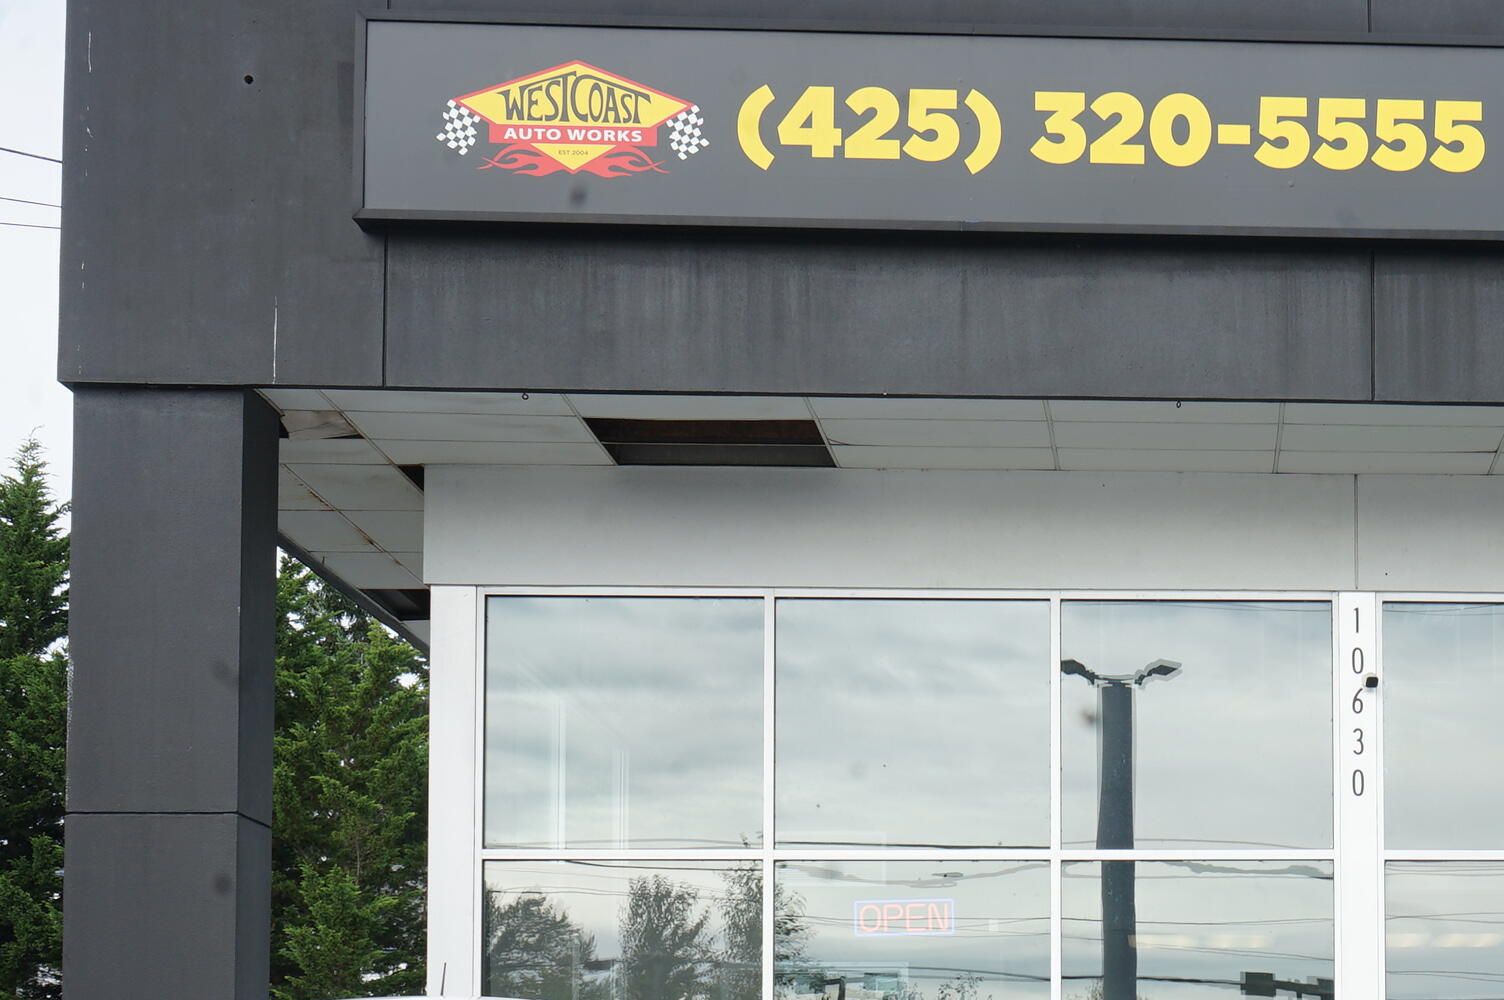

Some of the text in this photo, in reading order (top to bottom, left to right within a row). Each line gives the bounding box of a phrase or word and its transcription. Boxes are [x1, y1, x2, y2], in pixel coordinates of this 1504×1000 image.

[504, 128, 643, 142] AUTO WORKS
[737, 84, 1486, 175] (425) 320-5555
[1351, 606, 1366, 797] 10630
[859, 903, 949, 932] OPEN
